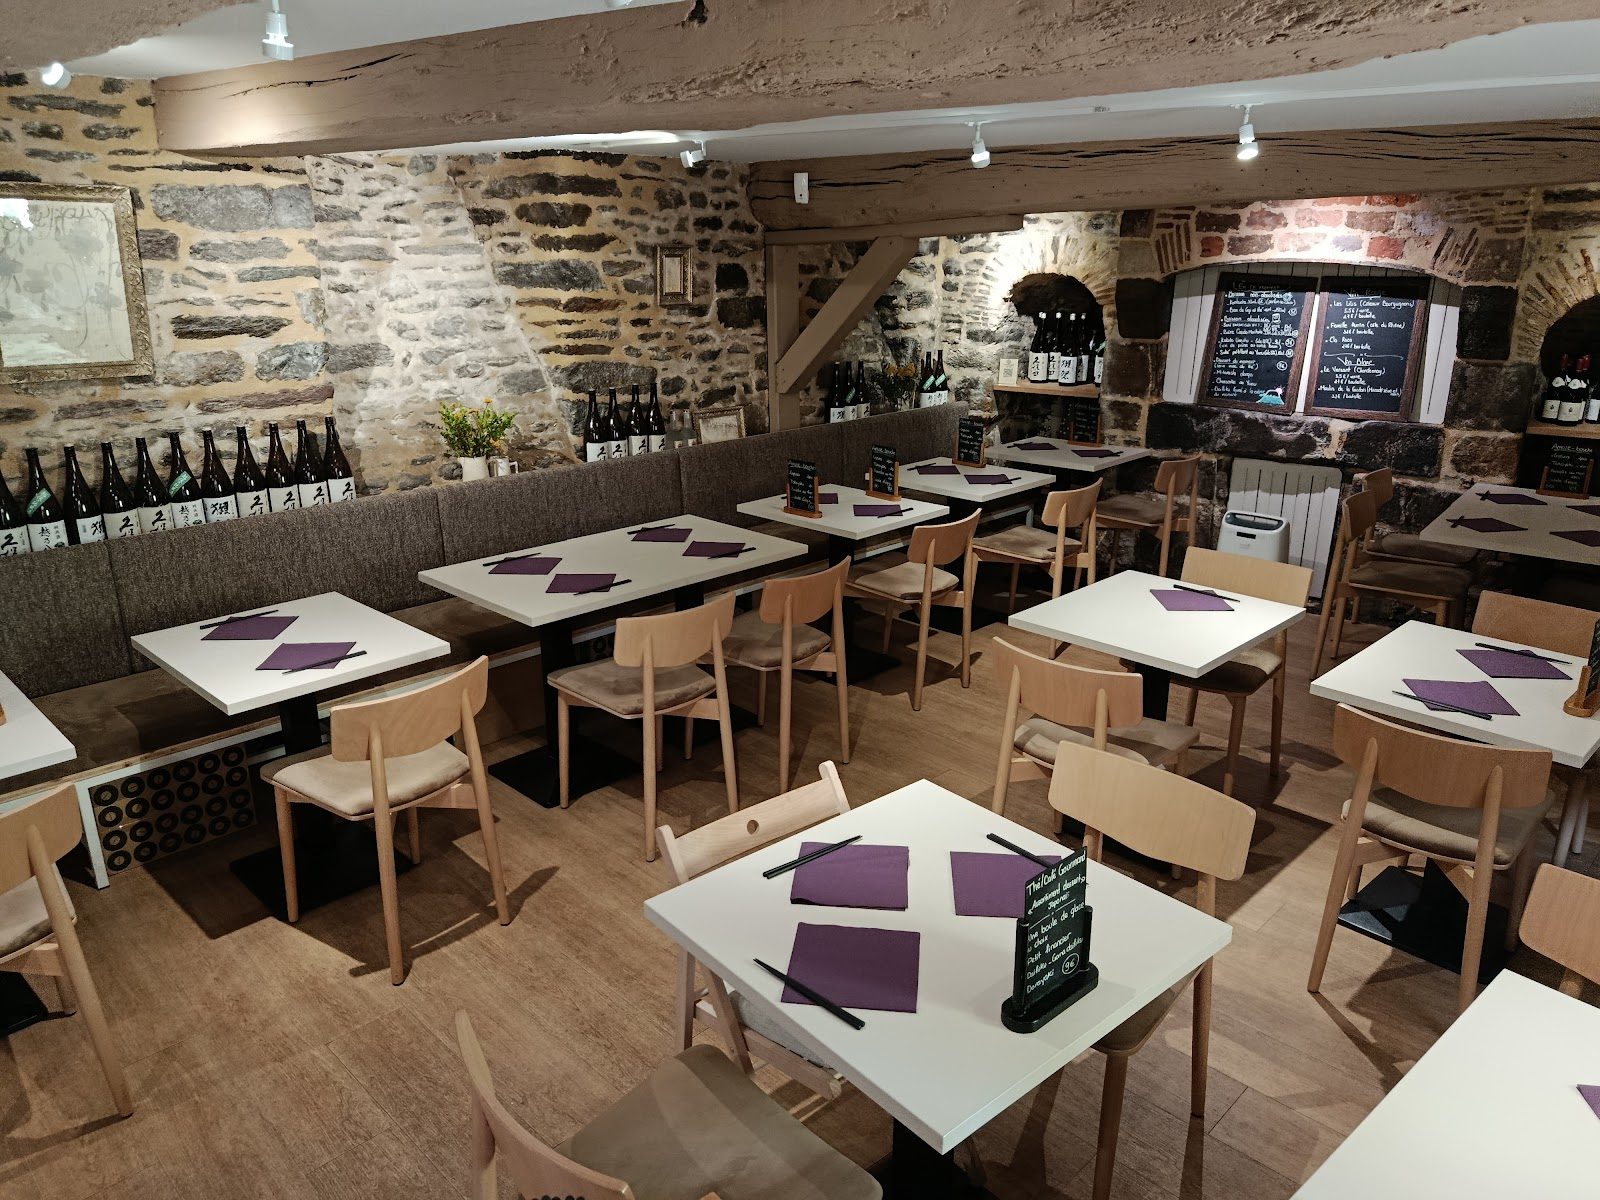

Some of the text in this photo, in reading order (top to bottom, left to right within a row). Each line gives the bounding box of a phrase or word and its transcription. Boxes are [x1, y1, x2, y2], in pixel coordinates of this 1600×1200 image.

[1058, 850, 1086, 876] Gourmand
[1041, 917, 1058, 934] boule
[1061, 910, 1069, 921] de
[1034, 935, 1049, 948] choix
